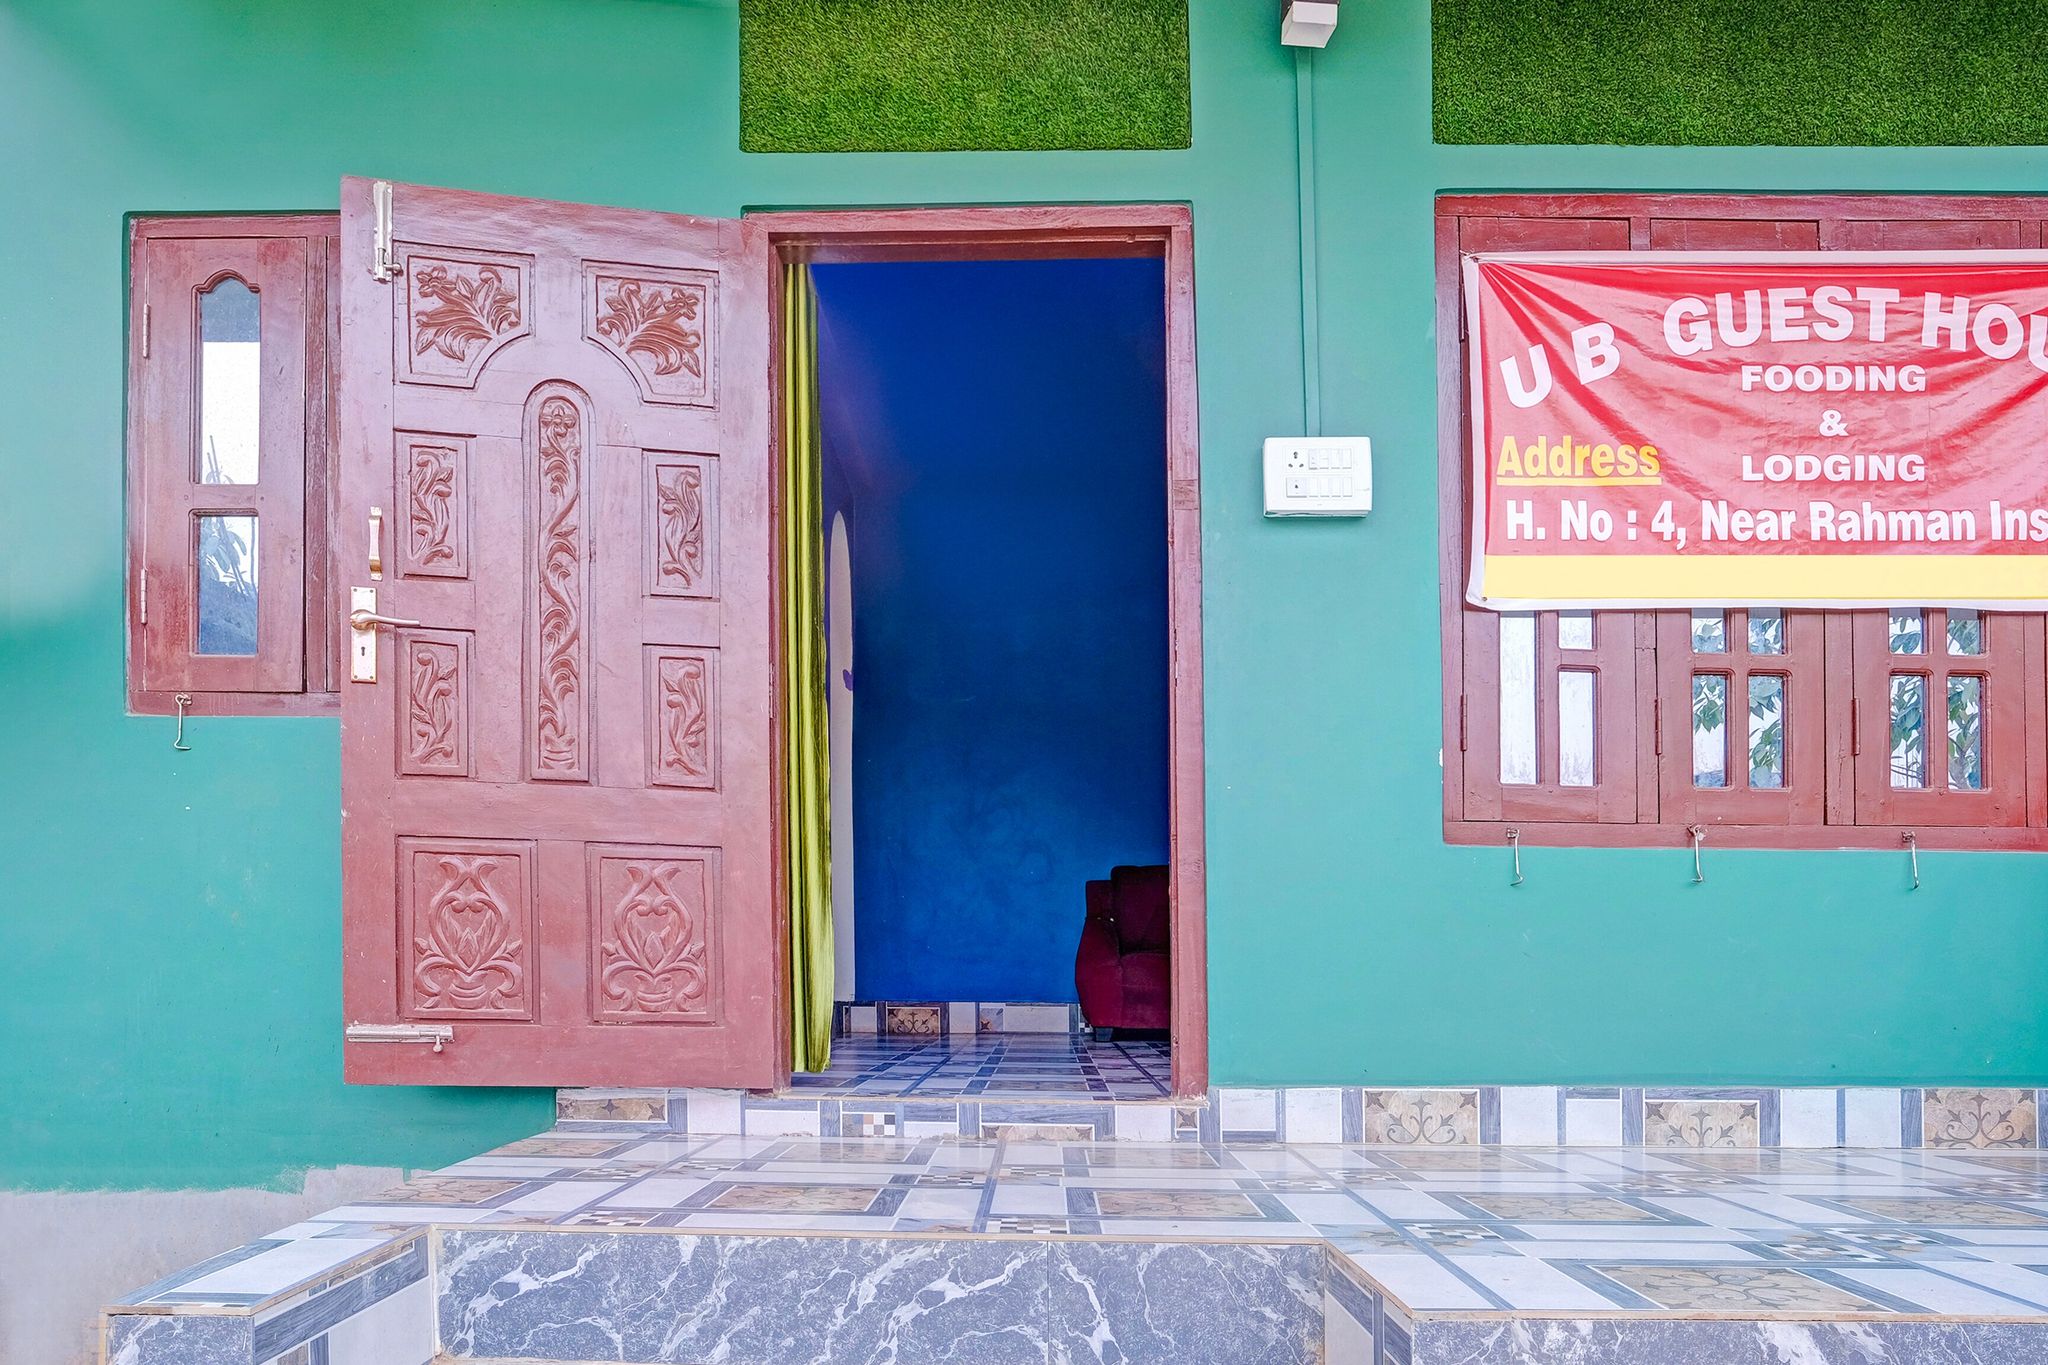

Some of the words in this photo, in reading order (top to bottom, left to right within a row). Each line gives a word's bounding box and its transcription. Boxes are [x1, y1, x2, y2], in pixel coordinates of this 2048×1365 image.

[1500, 344, 1553, 408] U
[1571, 322, 1622, 386] B
[1663, 285, 1900, 357] GUEST
[1741, 364, 1927, 393] FOODING
[1818, 409, 1849, 437] &
[1497, 435, 1661, 477] Address
[1742, 453, 1926, 482] LODGING
[1506, 500, 1546, 541] H.
[1651, 501, 1687, 551] 4,
[1701, 501, 1797, 543] Near
[1810, 500, 1976, 543] Rahman
